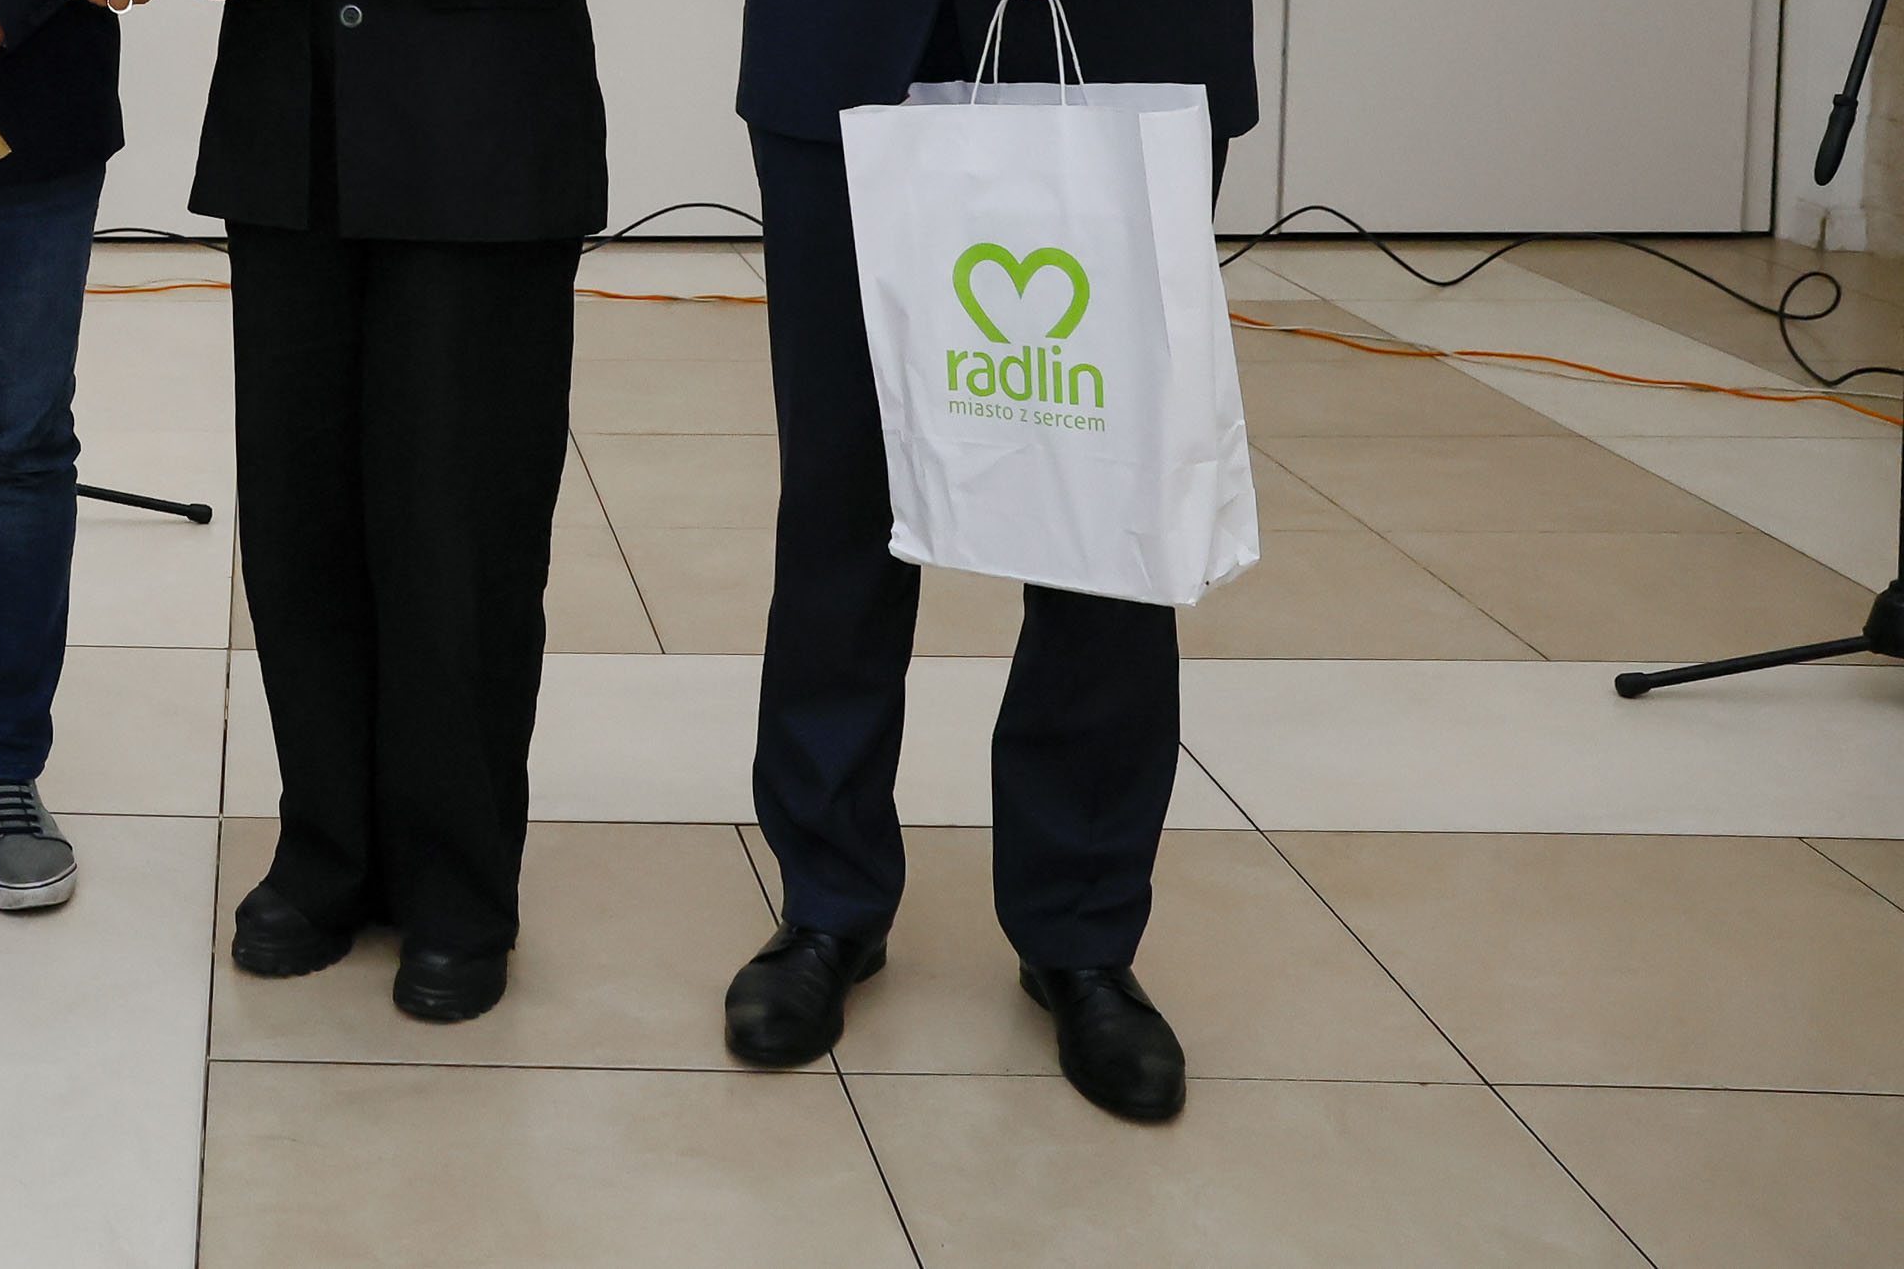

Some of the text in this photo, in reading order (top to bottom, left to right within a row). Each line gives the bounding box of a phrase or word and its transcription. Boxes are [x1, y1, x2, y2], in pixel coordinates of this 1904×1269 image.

[947, 345, 1104, 408] radlin
[949, 398, 1105, 431] miasto z sercem
